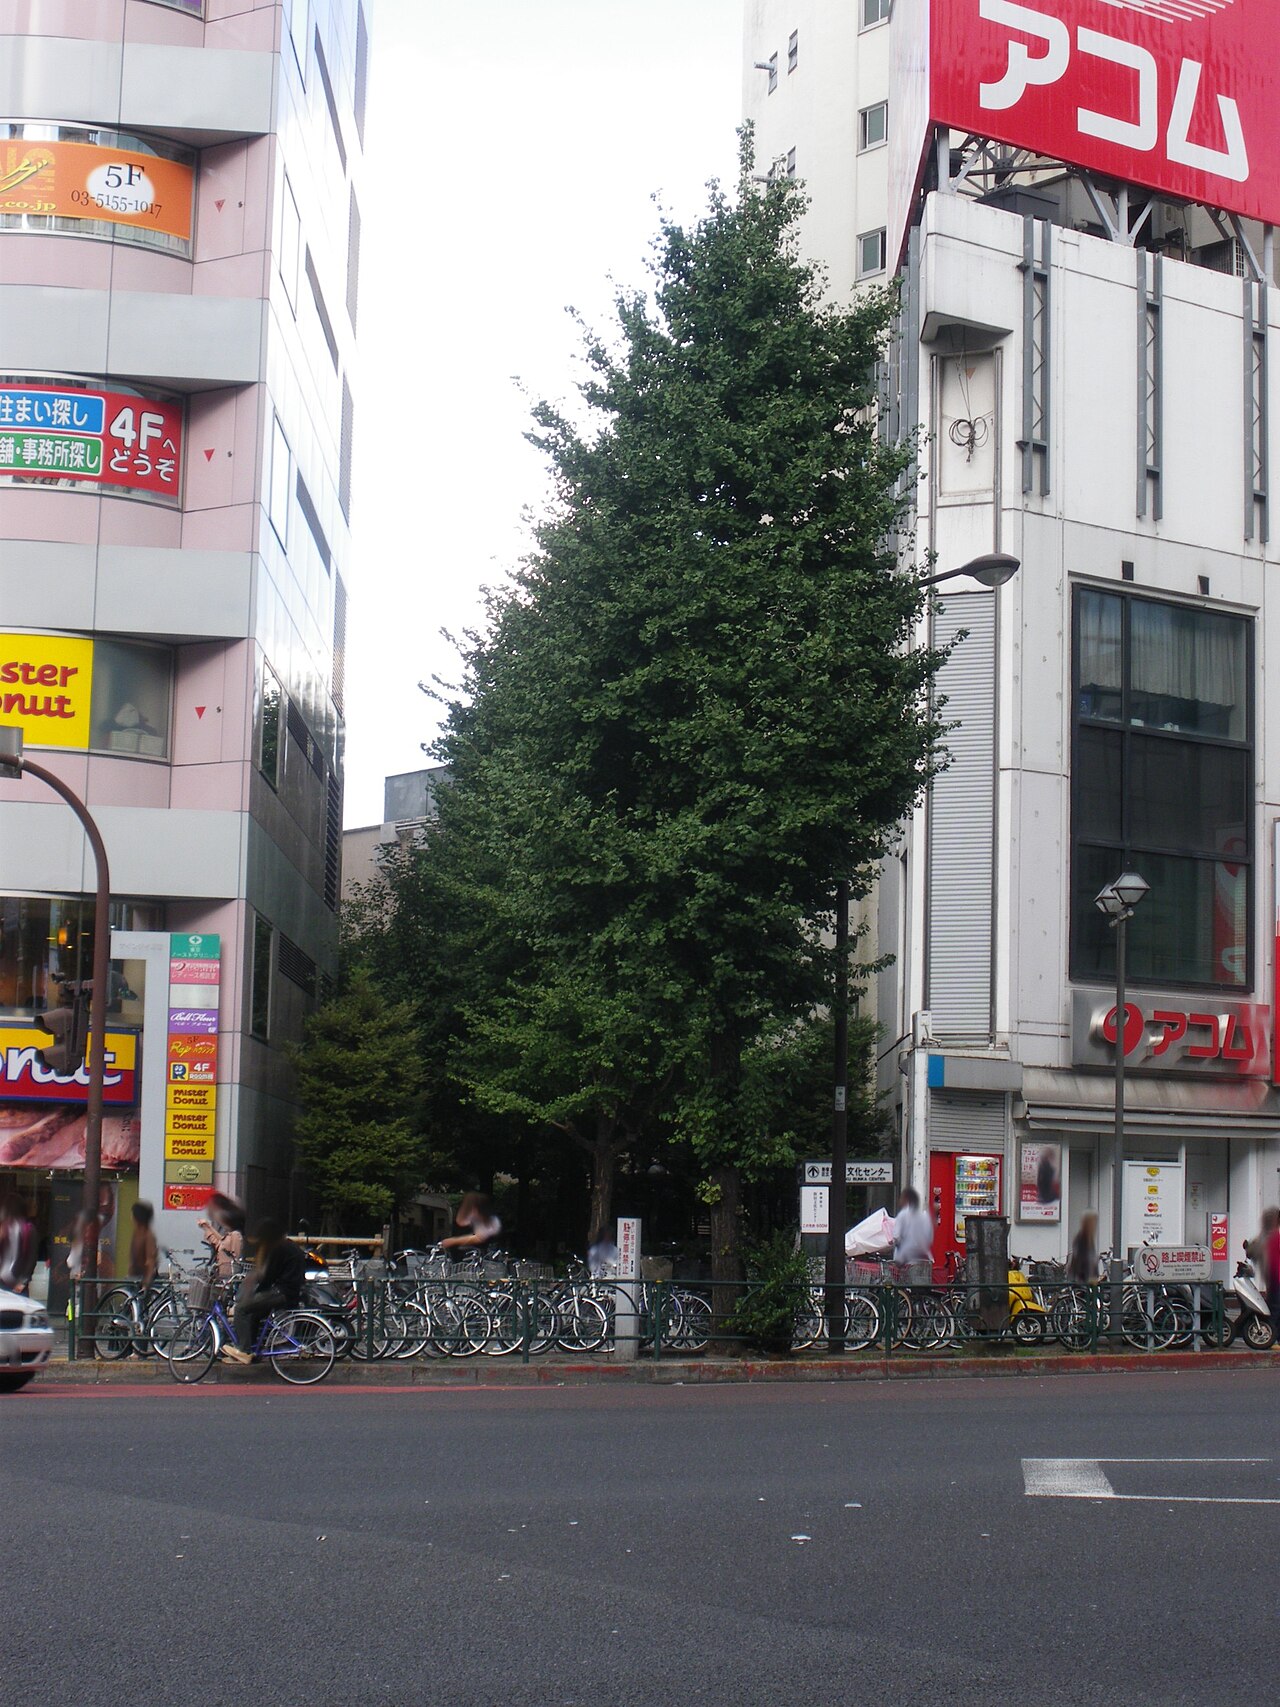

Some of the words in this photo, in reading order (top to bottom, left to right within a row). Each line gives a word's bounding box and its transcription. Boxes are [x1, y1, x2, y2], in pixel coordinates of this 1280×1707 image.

[979, 0, 1249, 183] アコム
[105, 163, 145, 188] 5F
[71, 190, 162, 219] 03-5155-1017
[0, 394, 88, 426] 住まい探し
[109, 448, 175, 482] どうぞ
[0, 661, 78, 687] ster
[0, 693, 75, 719] nut
[1153, 1010, 1254, 1060] アコム
[193, 1062, 210, 1072] 4F
[174, 1097, 208, 1105] Donut
[173, 1121, 208, 1129] Donut
[172, 1147, 207, 1155] Donut
[1212, 1226, 1227, 1234] アコム
[1161, 1251, 1206, 1263] 路上喫煙禁止
